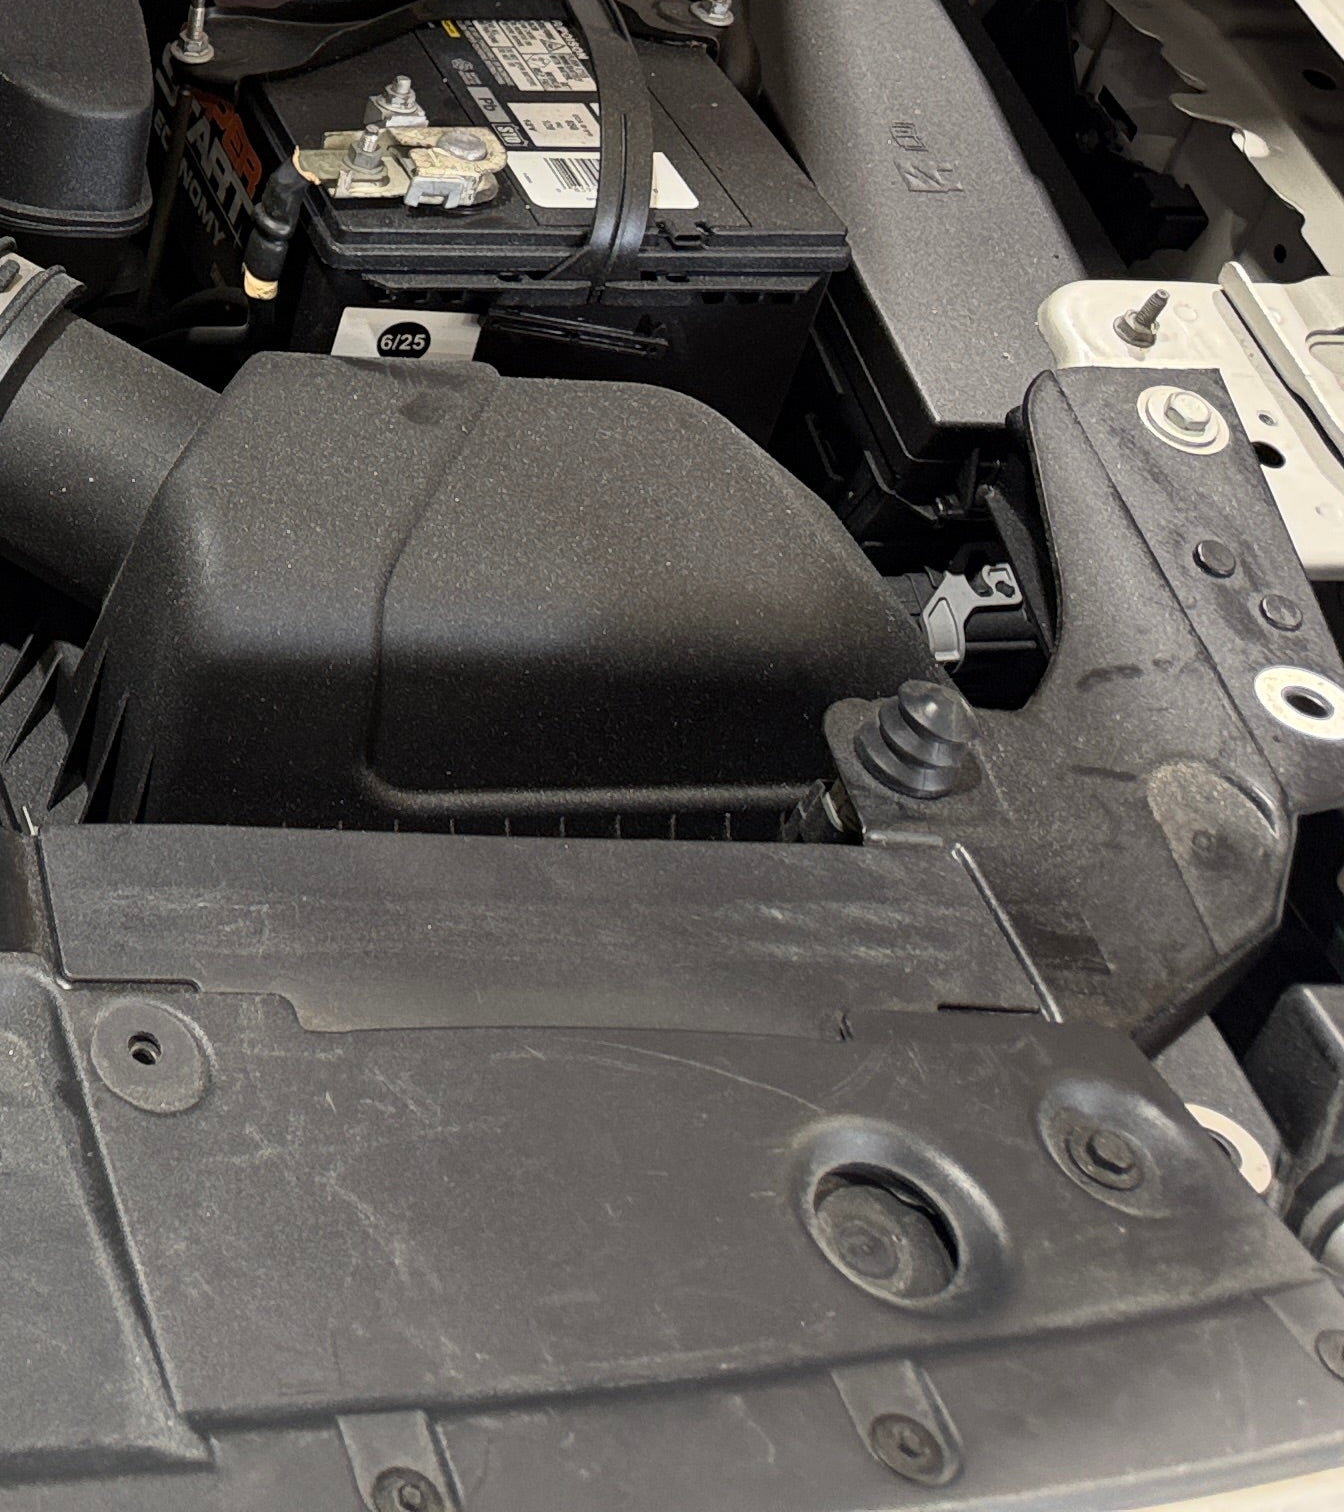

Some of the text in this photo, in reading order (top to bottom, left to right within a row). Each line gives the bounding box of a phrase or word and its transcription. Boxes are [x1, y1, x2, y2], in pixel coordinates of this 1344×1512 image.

[478, 97, 496, 112] Pb
[154, 108, 226, 246] ECNOMY
[380, 333, 427, 351] 6/25
